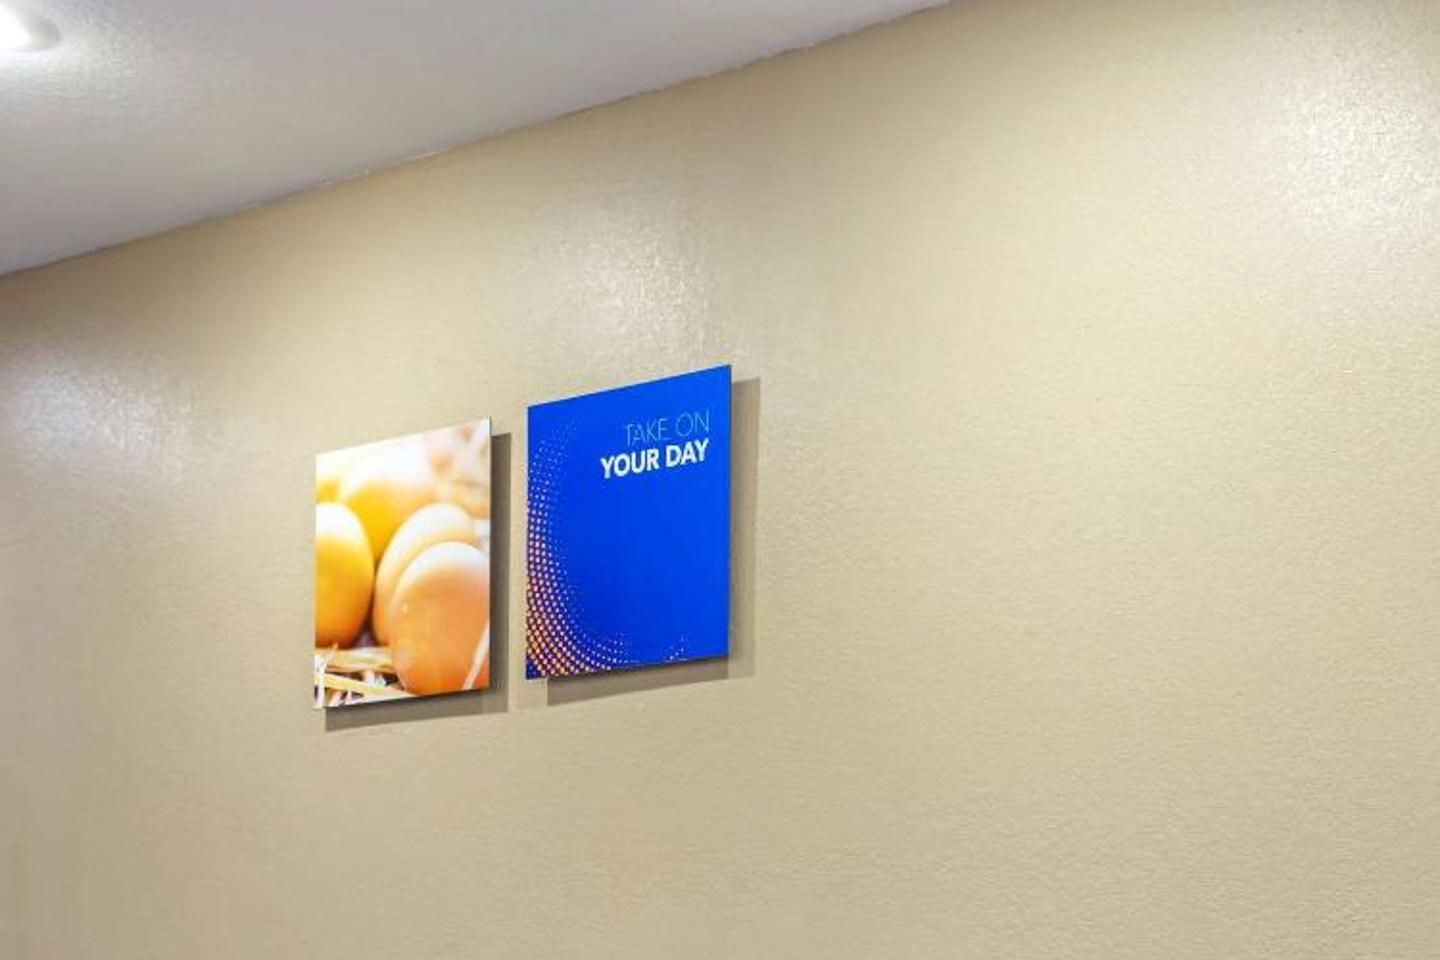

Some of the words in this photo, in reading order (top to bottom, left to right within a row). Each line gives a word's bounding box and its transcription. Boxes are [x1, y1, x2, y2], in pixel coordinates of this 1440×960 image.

[623, 417, 670, 447] TAKE
[675, 409, 710, 436] ON
[600, 447, 660, 480] YOUR
[664, 437, 710, 468] DAY
